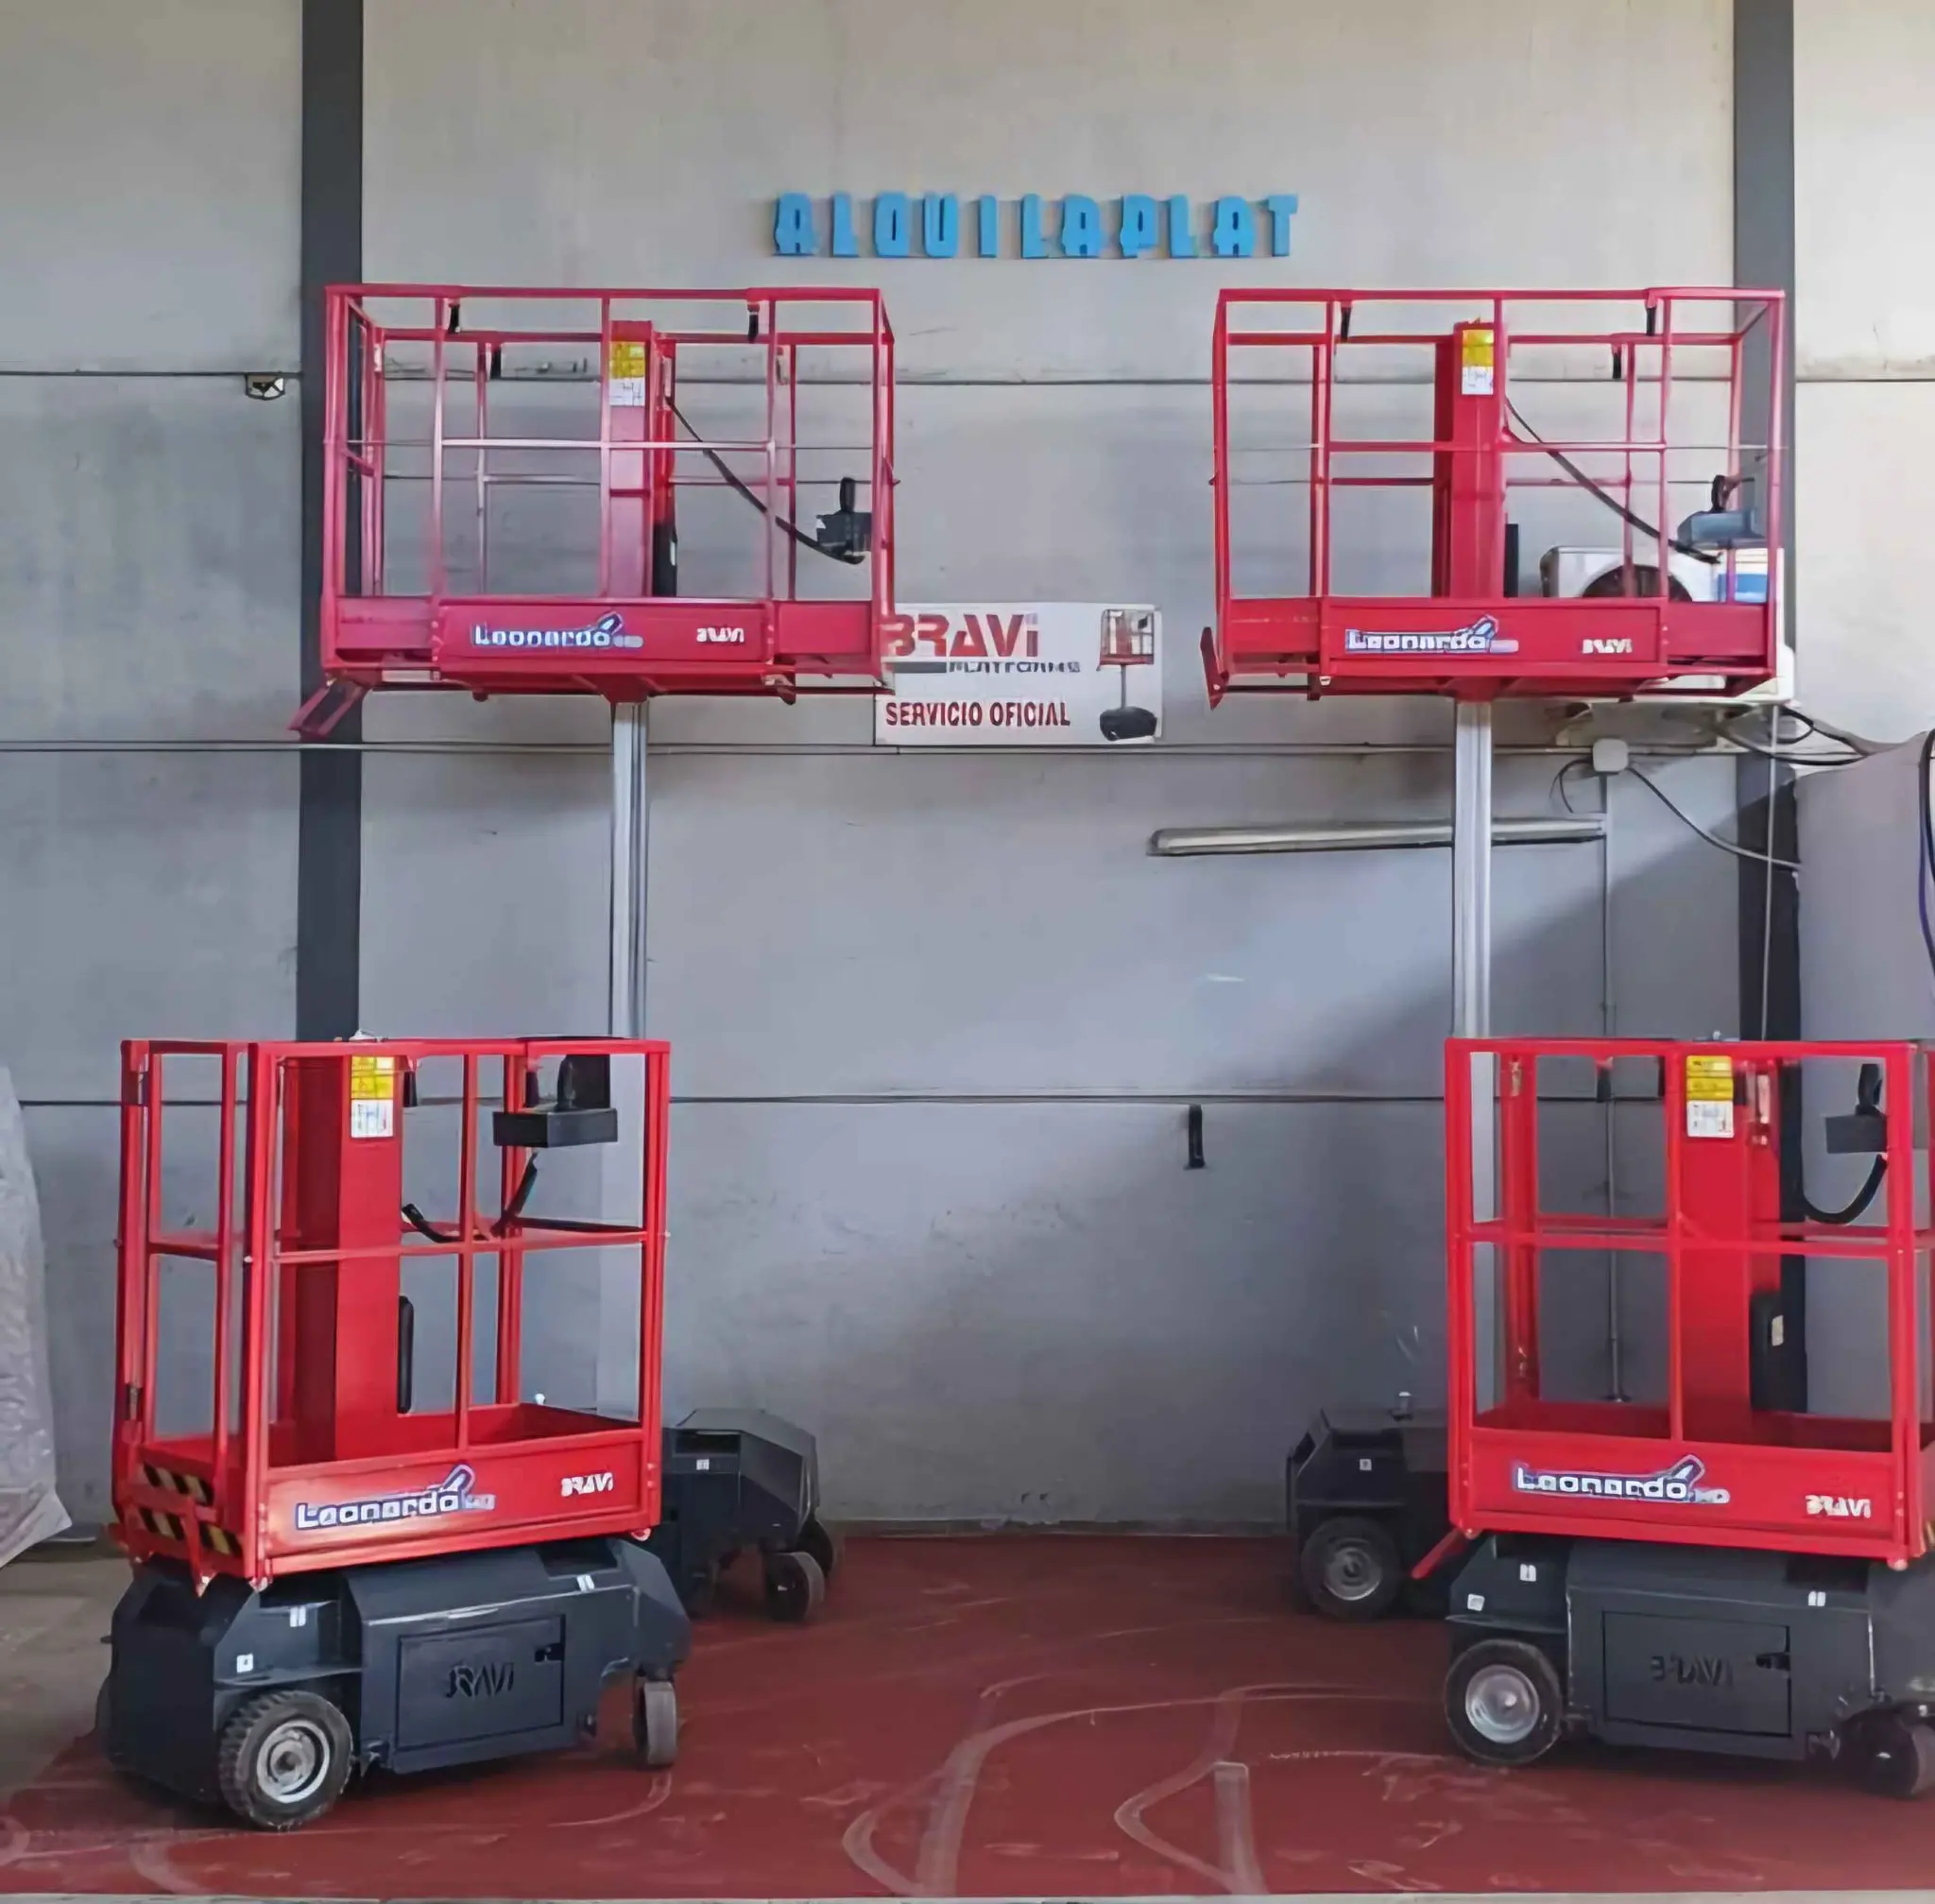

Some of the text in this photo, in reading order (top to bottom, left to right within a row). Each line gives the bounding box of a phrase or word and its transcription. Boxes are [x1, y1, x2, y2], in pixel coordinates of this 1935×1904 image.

[773, 190, 1299, 258] ALQUILAPLAT
[885, 702, 1070, 727] SERVICIO OFICIAL
[1515, 1467, 1689, 1500] Leonardo
[296, 1480, 463, 1529] Leonardo
